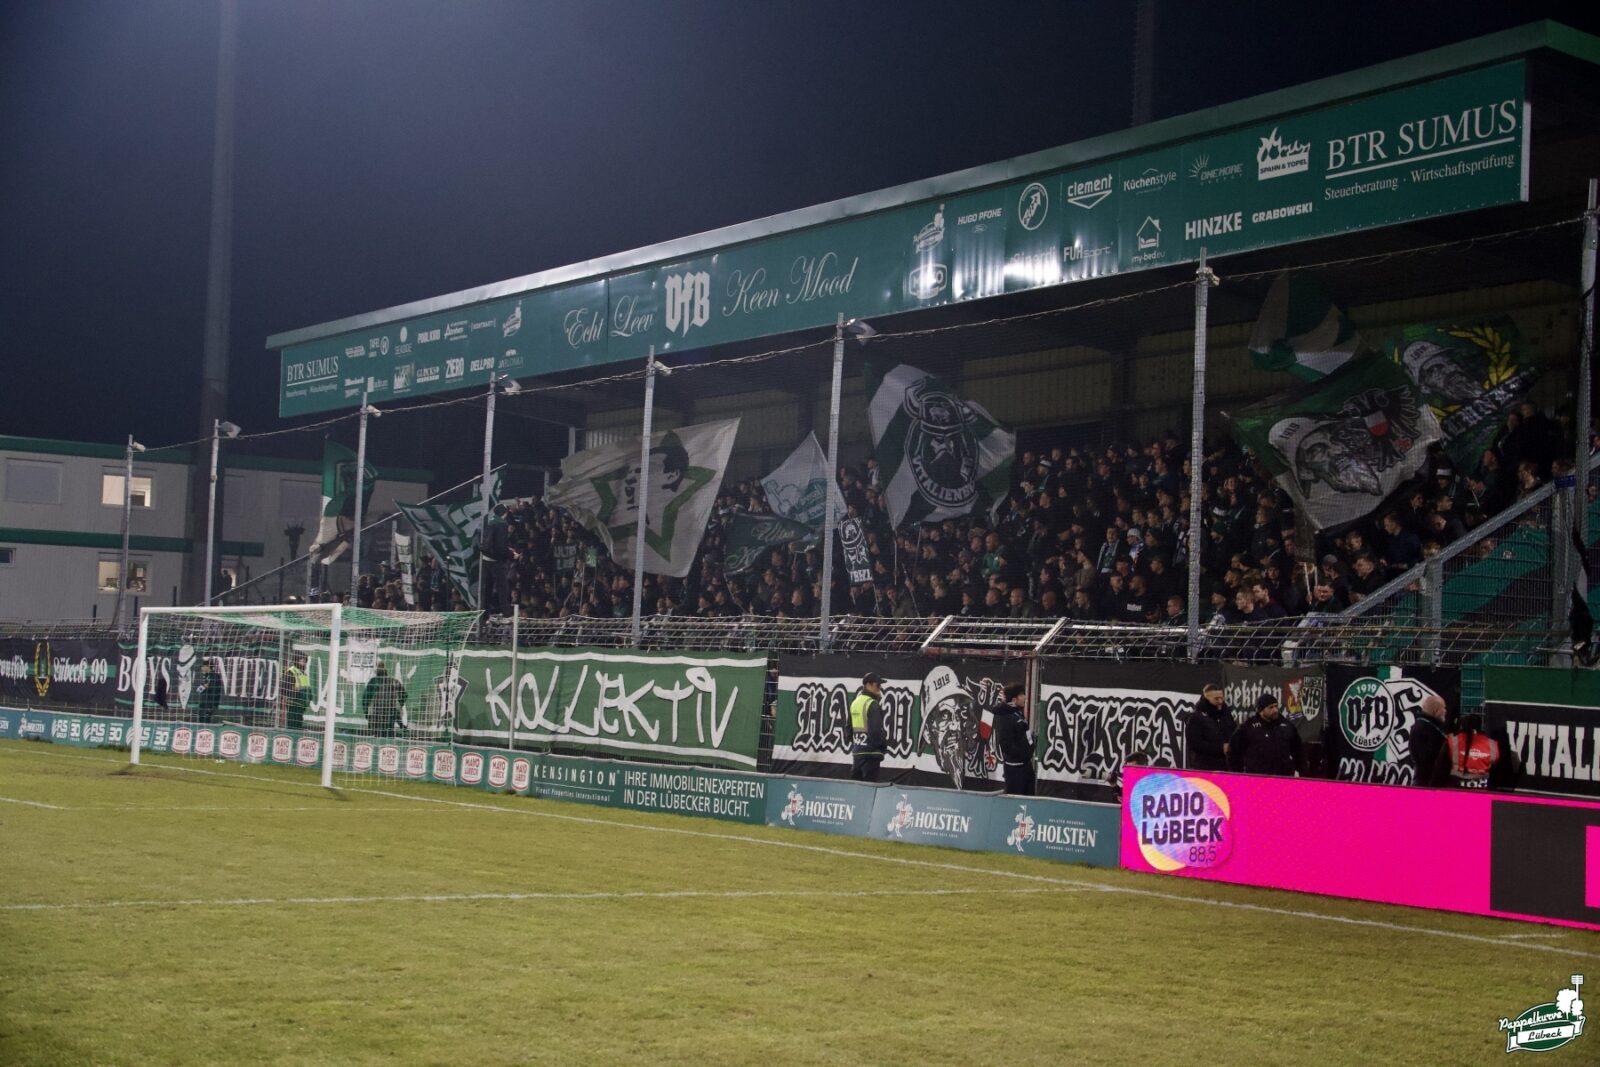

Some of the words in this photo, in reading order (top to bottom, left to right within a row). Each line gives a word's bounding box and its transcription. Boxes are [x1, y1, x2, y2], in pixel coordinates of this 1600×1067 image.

[1327, 129, 1388, 171] BTR
[1397, 99, 1517, 156] SUMUS
[1260, 164, 1281, 174] SPAHN
[1287, 158, 1308, 169] TOPEL
[1067, 173, 1113, 197] clement
[1123, 170, 1177, 191] Küchenstyle
[1324, 177, 1398, 201] Steuerberatung
[1410, 154, 1515, 184] Wirtschaftsprüfung
[957, 214, 977, 225] HUGO
[1252, 202, 1313, 224] GRABOWSKI
[1185, 211, 1243, 240] HINZKE
[722, 267, 781, 317] Keen
[785, 252, 859, 304] Mood
[564, 308, 604, 350] Echt
[611, 295, 655, 337] Leev
[287, 363, 305, 382] BTR
[306, 355, 339, 378] SUMUS
[90, 658, 108, 684] 99
[1356, 683, 1377, 694] 1919
[485, 664, 738, 748] KOLLEKTIV
[1346, 693, 1390, 737] VfB
[70, 723, 81, 737] 30
[109, 726, 122, 741] 30
[154, 730, 169, 746] 30
[301, 742, 315, 750] MAYO
[334, 744, 345, 753] AYO
[1354, 735, 1383, 747] LÜBECK
[437, 755, 453, 764] MAYO
[465, 758, 480, 768] MAYO
[492, 761, 505, 770] MAYO
[516, 764, 527, 773] MAYO
[533, 765, 616, 786] KENSINGTON
[624, 771, 648, 787] IHRE
[650, 773, 764, 799] IMMOBILIENEXPERTEN
[624, 789, 634, 805] IN
[637, 791, 657, 807] DER
[660, 791, 710, 812] LÜBECKER
[713, 798, 750, 817] BUCHT.
[805, 800, 853, 821] HOLSTEN
[1142, 791, 1204, 819] RADIO
[914, 811, 969, 832] HOLSTEN
[1142, 817, 1224, 844] LÜBECK
[1037, 823, 1096, 847] HOLSTEN
[1189, 846, 1217, 863] 88,5
